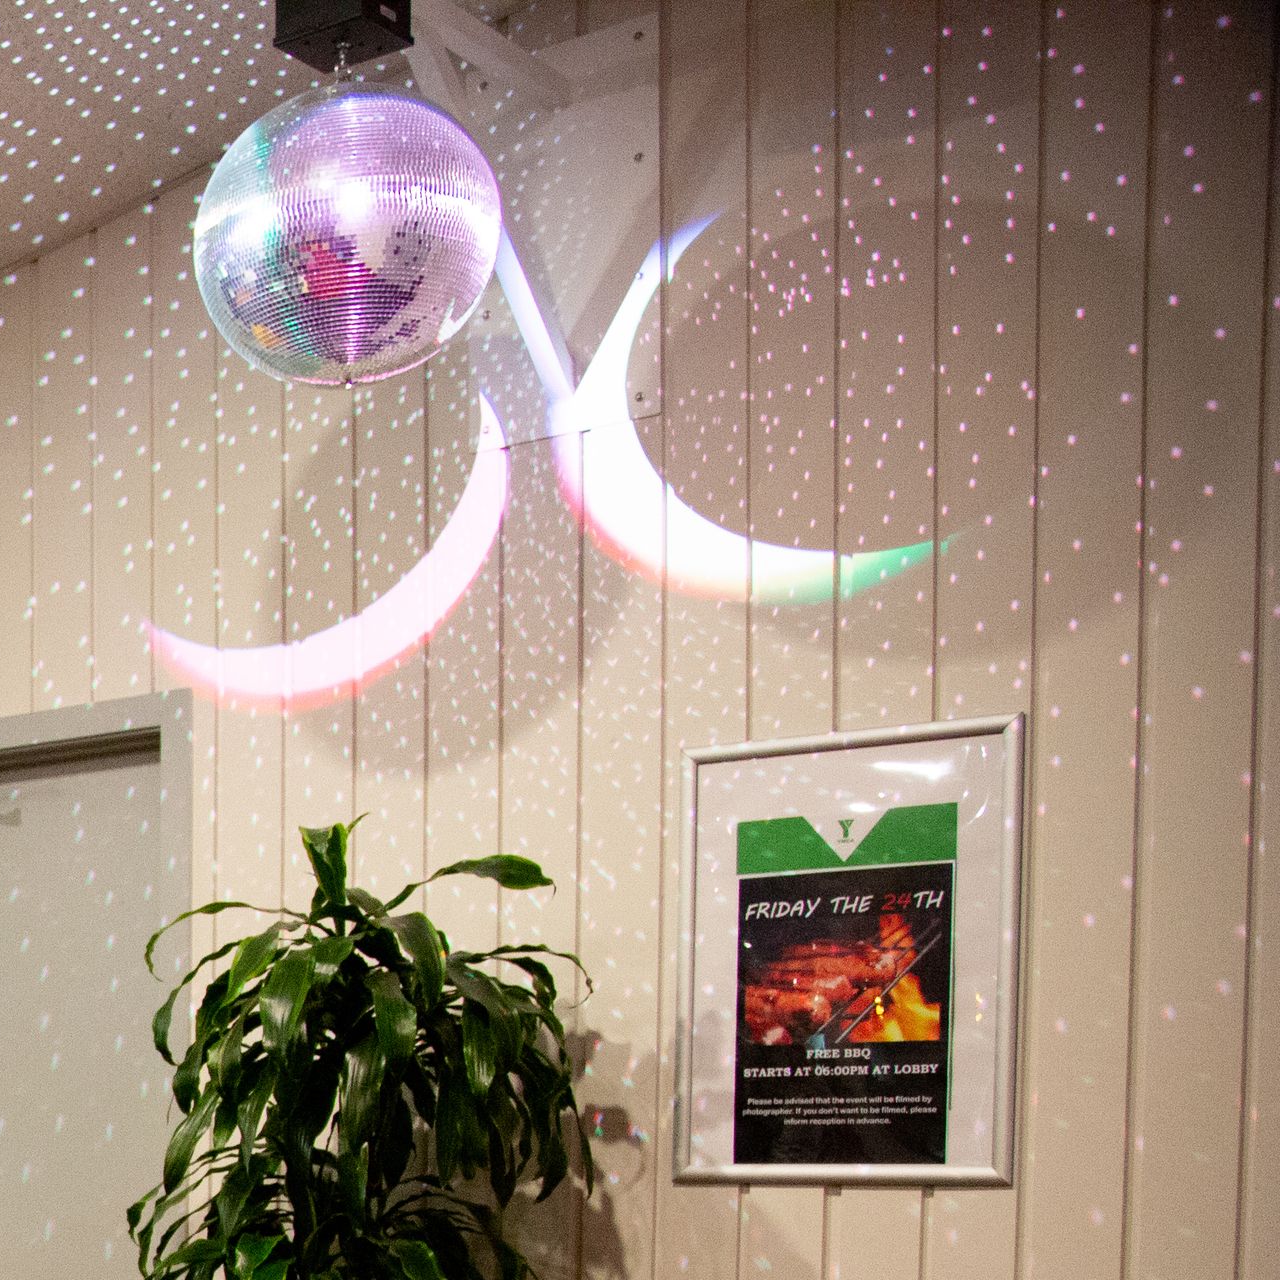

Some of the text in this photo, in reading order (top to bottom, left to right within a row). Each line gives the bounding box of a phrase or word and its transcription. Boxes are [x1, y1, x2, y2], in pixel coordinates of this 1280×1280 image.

[745, 897, 821, 921] FRIDAY
[830, 895, 874, 914] THE
[806, 1048, 872, 1060] FREE BBQ
[743, 1064, 939, 1078] STARTS AT 06:00PM AT LOBBY
[773, 1097, 784, 1105] be
[895, 1095, 920, 1103] filmed
[922, 1095, 933, 1104] by
[803, 1108, 817, 1116] you
[818, 1107, 838, 1115] don't
[860, 1106, 868, 1114] to
[869, 1106, 880, 1114] be
[910, 1106, 938, 1114] please
[809, 1118, 846, 1126] reception
